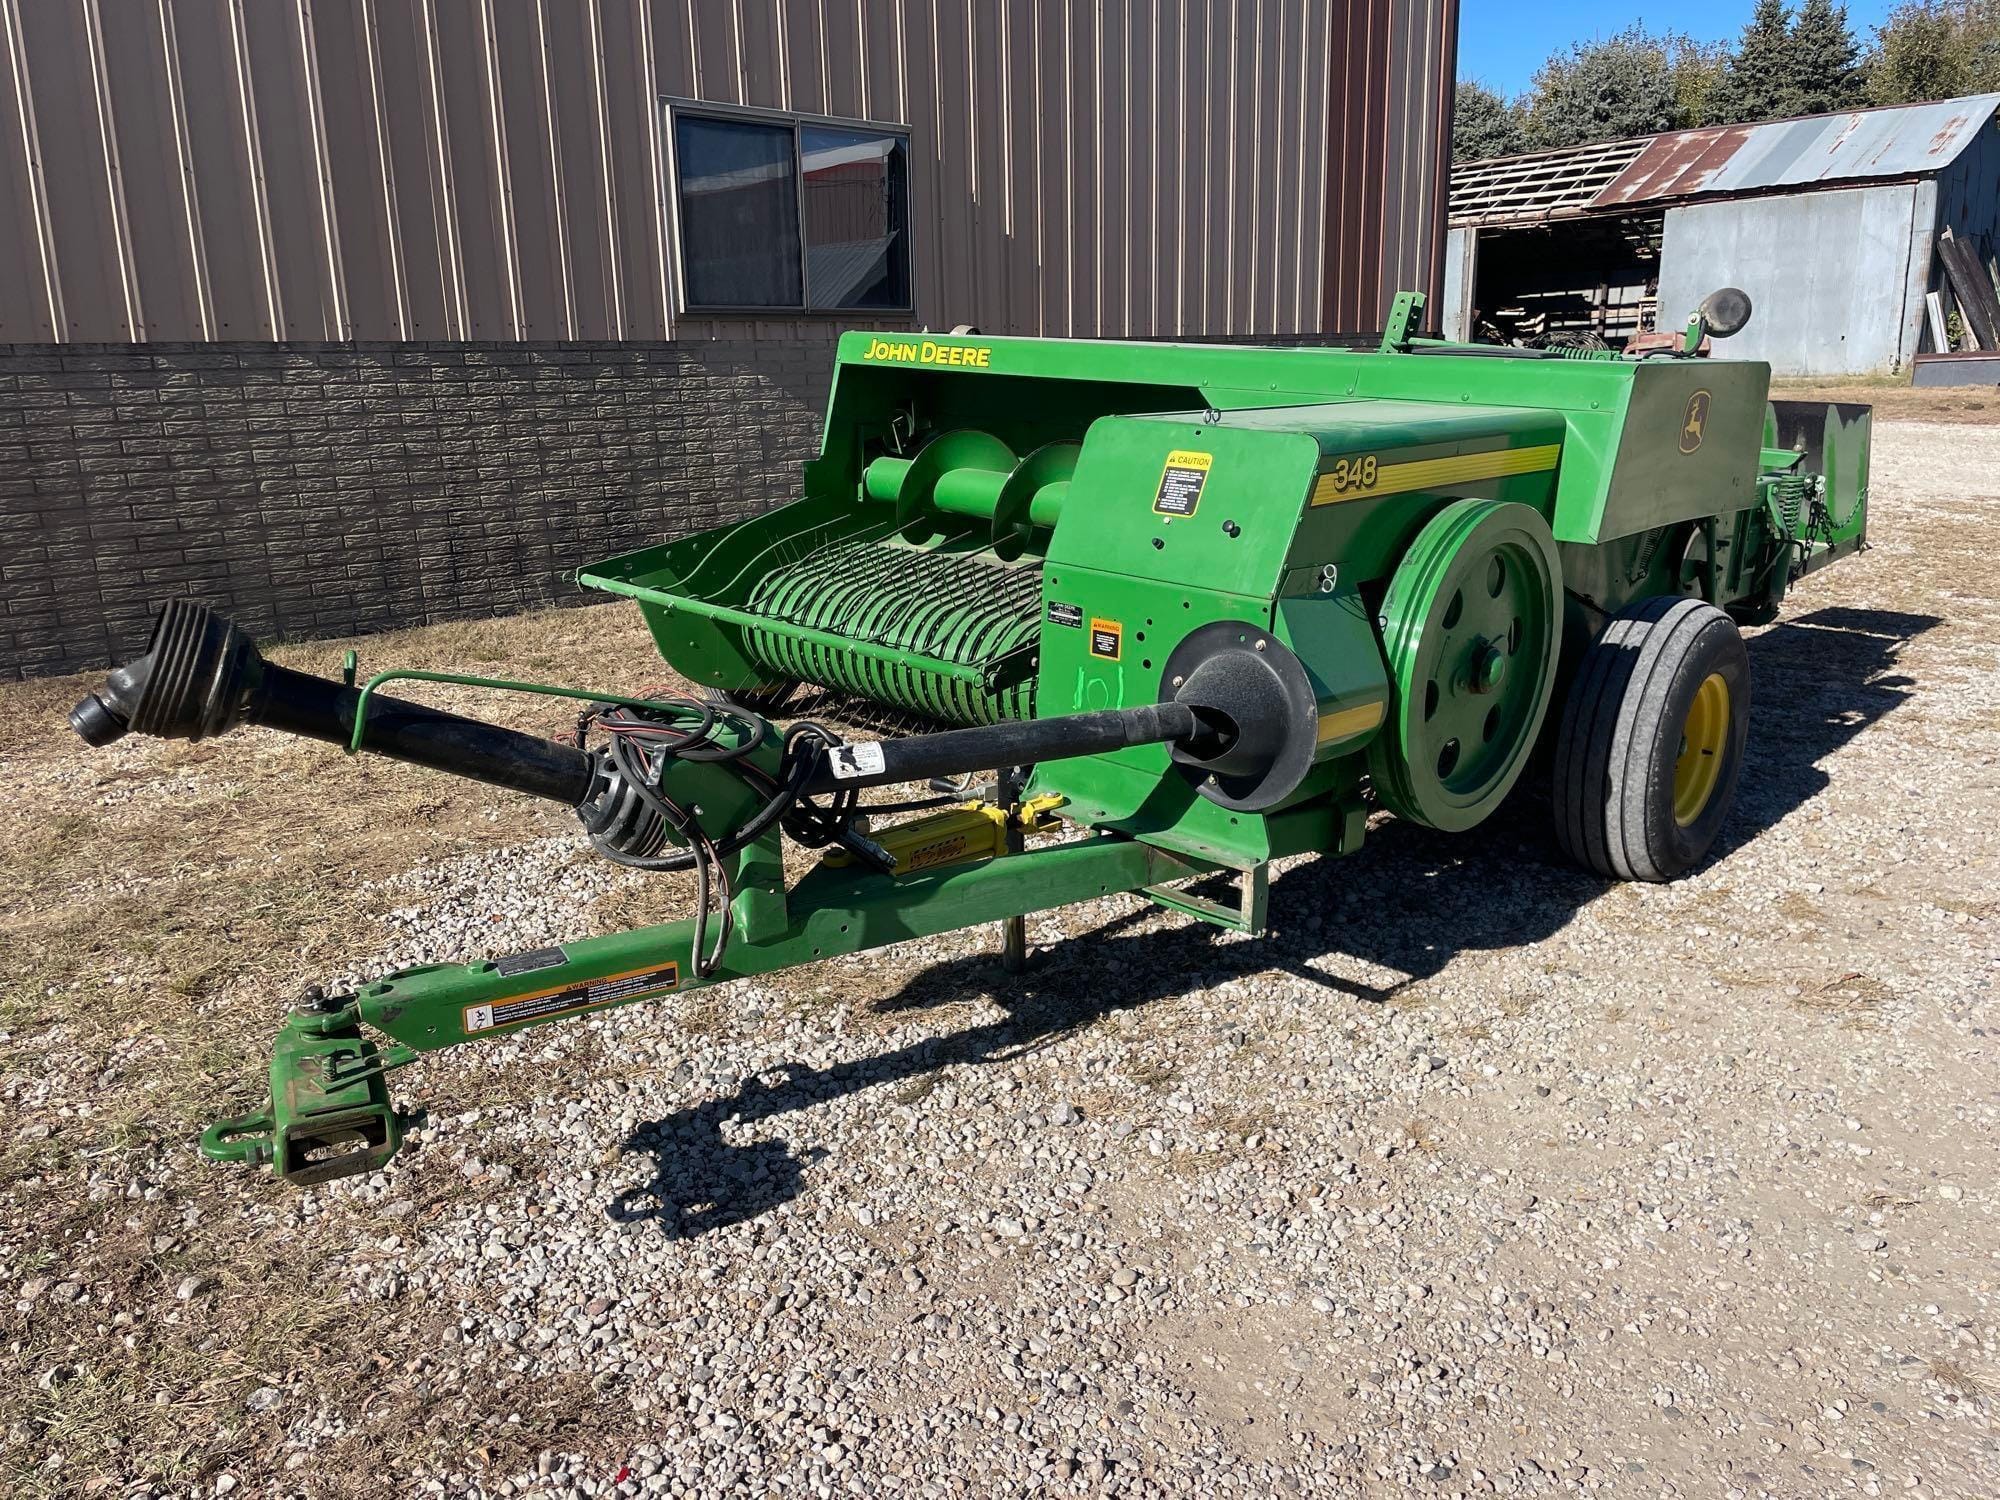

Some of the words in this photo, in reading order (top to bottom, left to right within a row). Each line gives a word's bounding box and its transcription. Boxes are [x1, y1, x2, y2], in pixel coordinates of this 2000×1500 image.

[864, 338, 918, 362] JOHN
[920, 341, 992, 368] DEERE
[1178, 456, 1210, 466] CAUTION
[1334, 455, 1377, 492] 348
[1097, 623, 1120, 632] WARNING
[571, 977, 608, 991] WARNING
